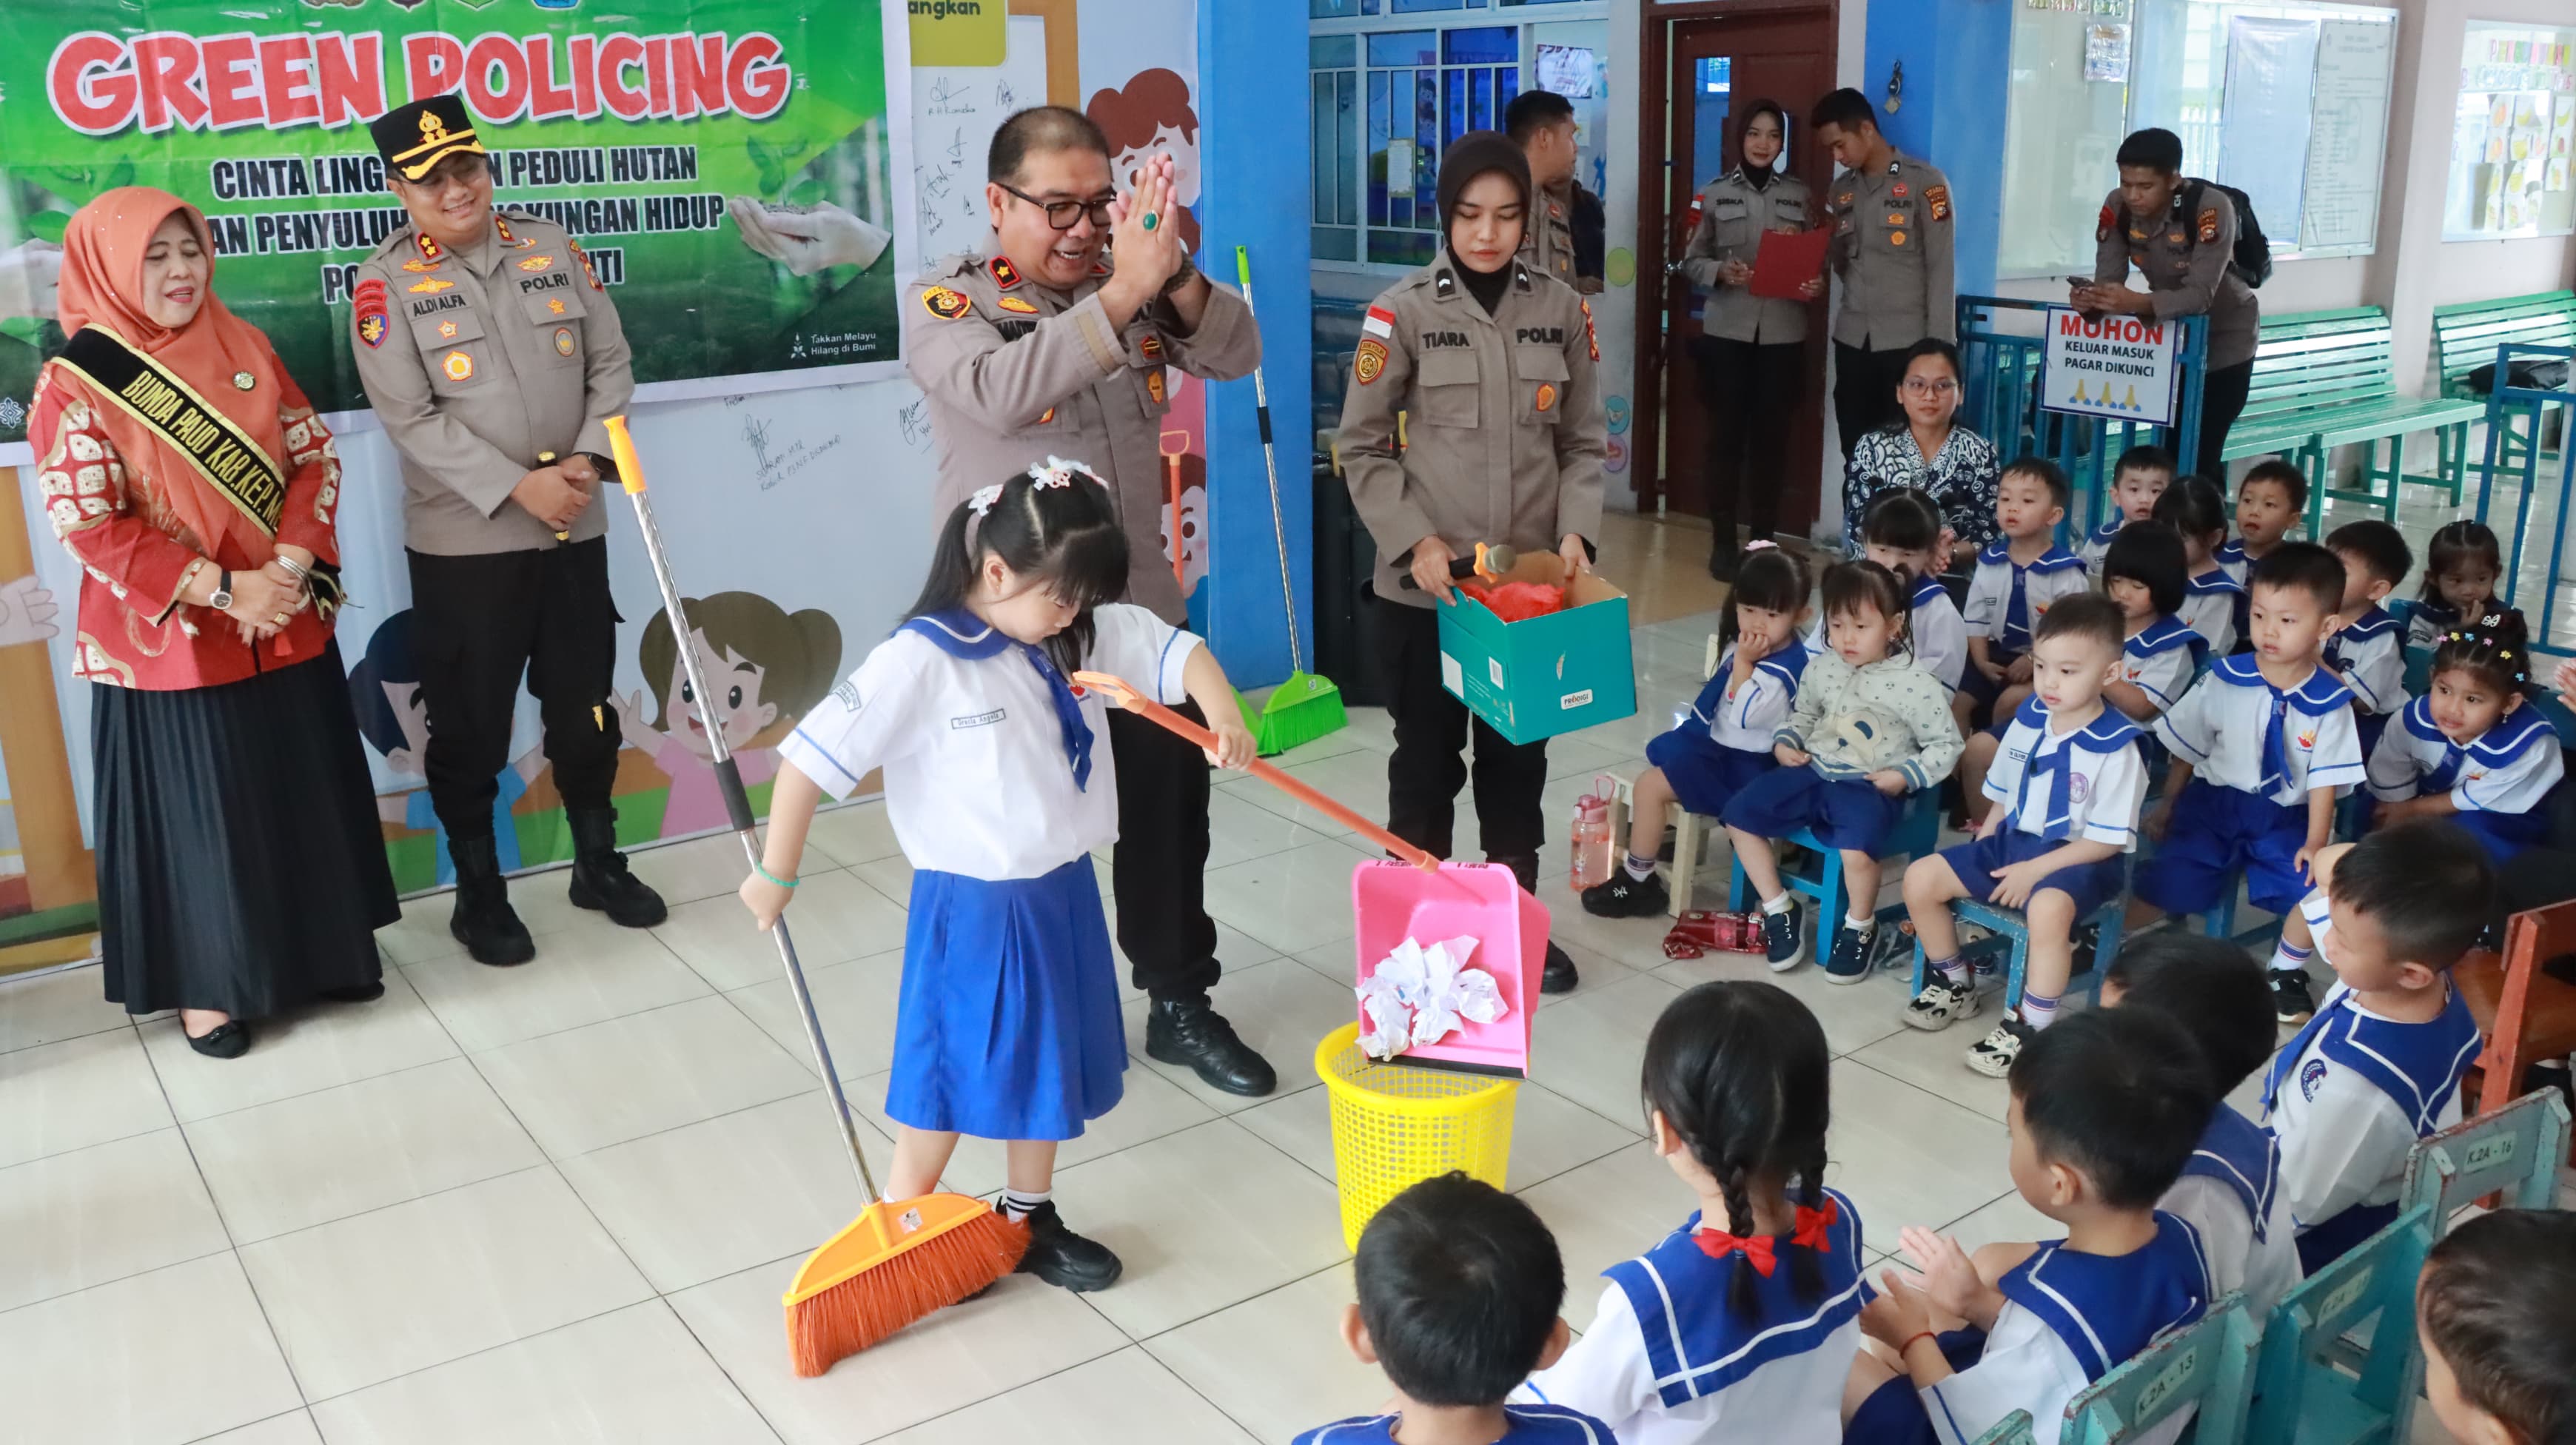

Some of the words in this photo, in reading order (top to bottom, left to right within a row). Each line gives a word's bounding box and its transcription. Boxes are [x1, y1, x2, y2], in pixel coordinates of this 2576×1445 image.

[908, 0, 981, 20] angkan
[47, 31, 386, 134] GREEN
[401, 32, 791, 123] POLICING
[212, 158, 308, 201] CINTA
[508, 147, 606, 187] PEDULI
[610, 145, 697, 182] HUTAN
[1884, 199, 1912, 208] POLRI
[210, 215, 250, 255] AN
[643, 194, 725, 232] HIDUP
[520, 272, 569, 293] POLRI
[413, 298, 437, 317] ALDI
[440, 294, 466, 309] ALFA
[811, 334, 842, 343] Takkan
[844, 332, 876, 341] Melayu
[1422, 331, 1470, 349] TIARA
[1516, 327, 1563, 343] POLRI
[2060, 314, 2164, 345] MOHON
[811, 346, 839, 355] Hilang
[841, 344, 851, 352] di
[852, 343, 876, 352] Bumi
[2065, 340, 2109, 355] KELUAR
[2111, 345, 2155, 361] MASUK
[2065, 357, 2103, 372] PAGAR
[2105, 361, 2155, 378] DIKUNCI
[121, 369, 184, 425] BUNDA
[168, 406, 221, 455] PAUD
